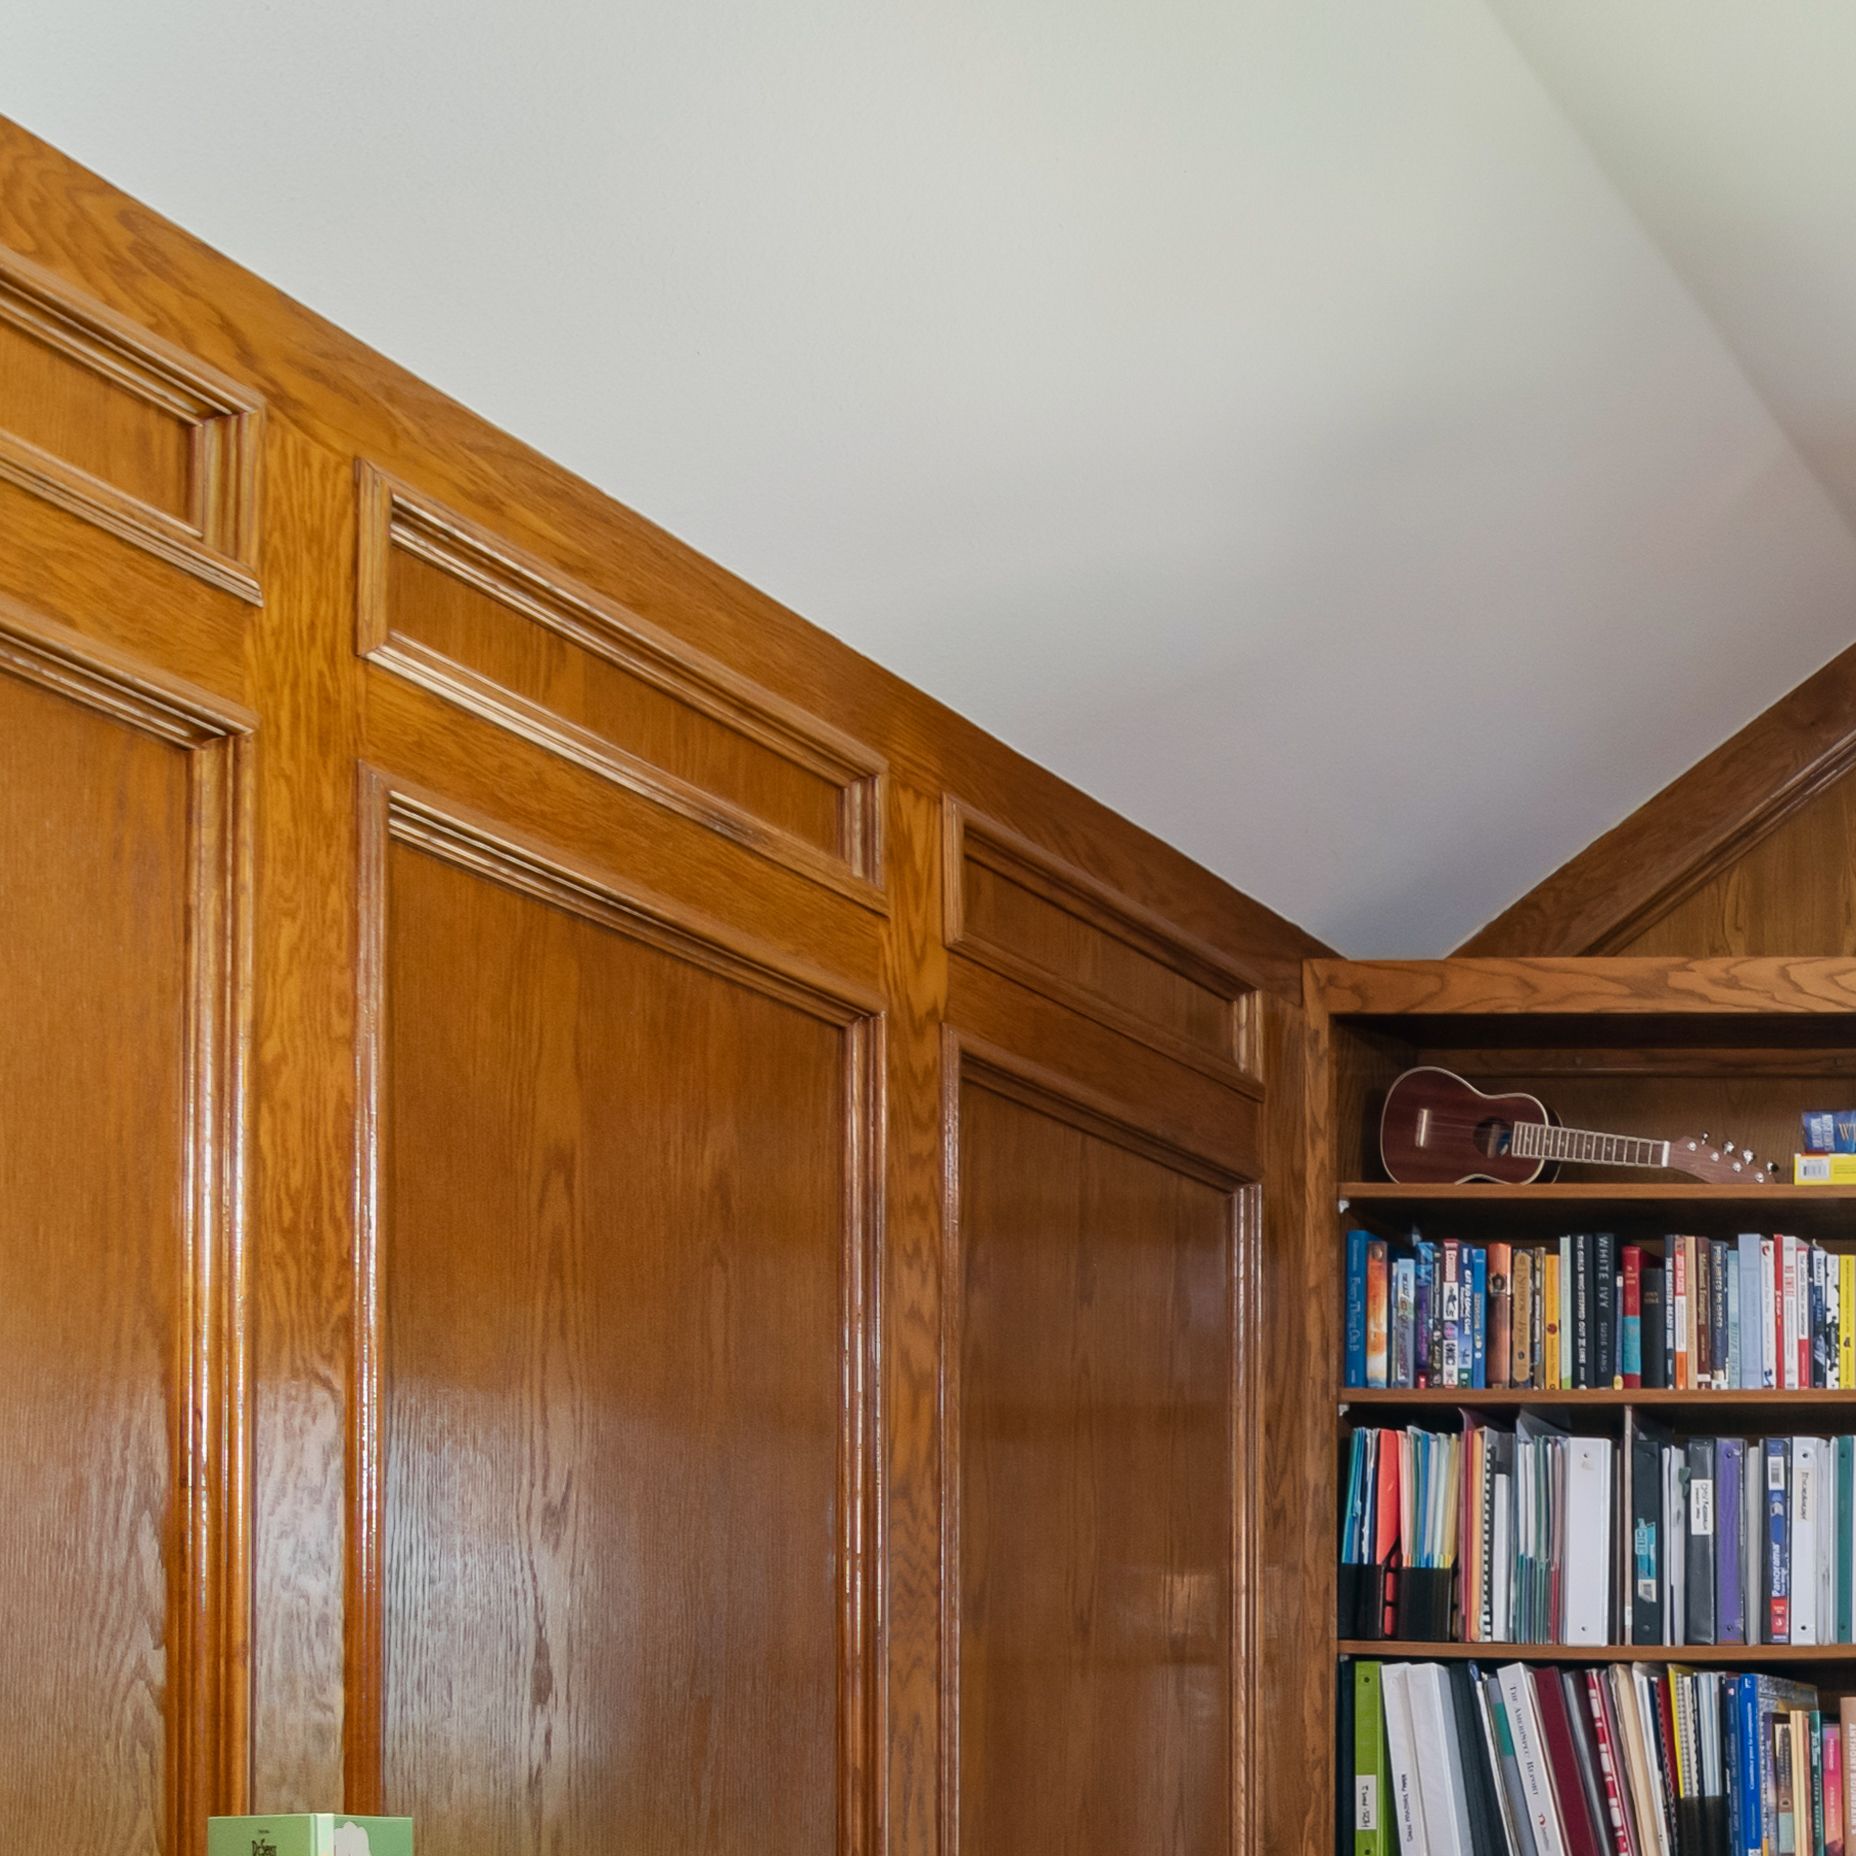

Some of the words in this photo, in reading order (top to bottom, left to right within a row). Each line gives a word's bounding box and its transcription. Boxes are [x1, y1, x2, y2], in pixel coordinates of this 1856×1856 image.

[1598, 1236, 1610, 1280] WHITE
[1599, 1286, 1610, 1308] IVY
[1772, 1542, 1781, 1597] Panorama
